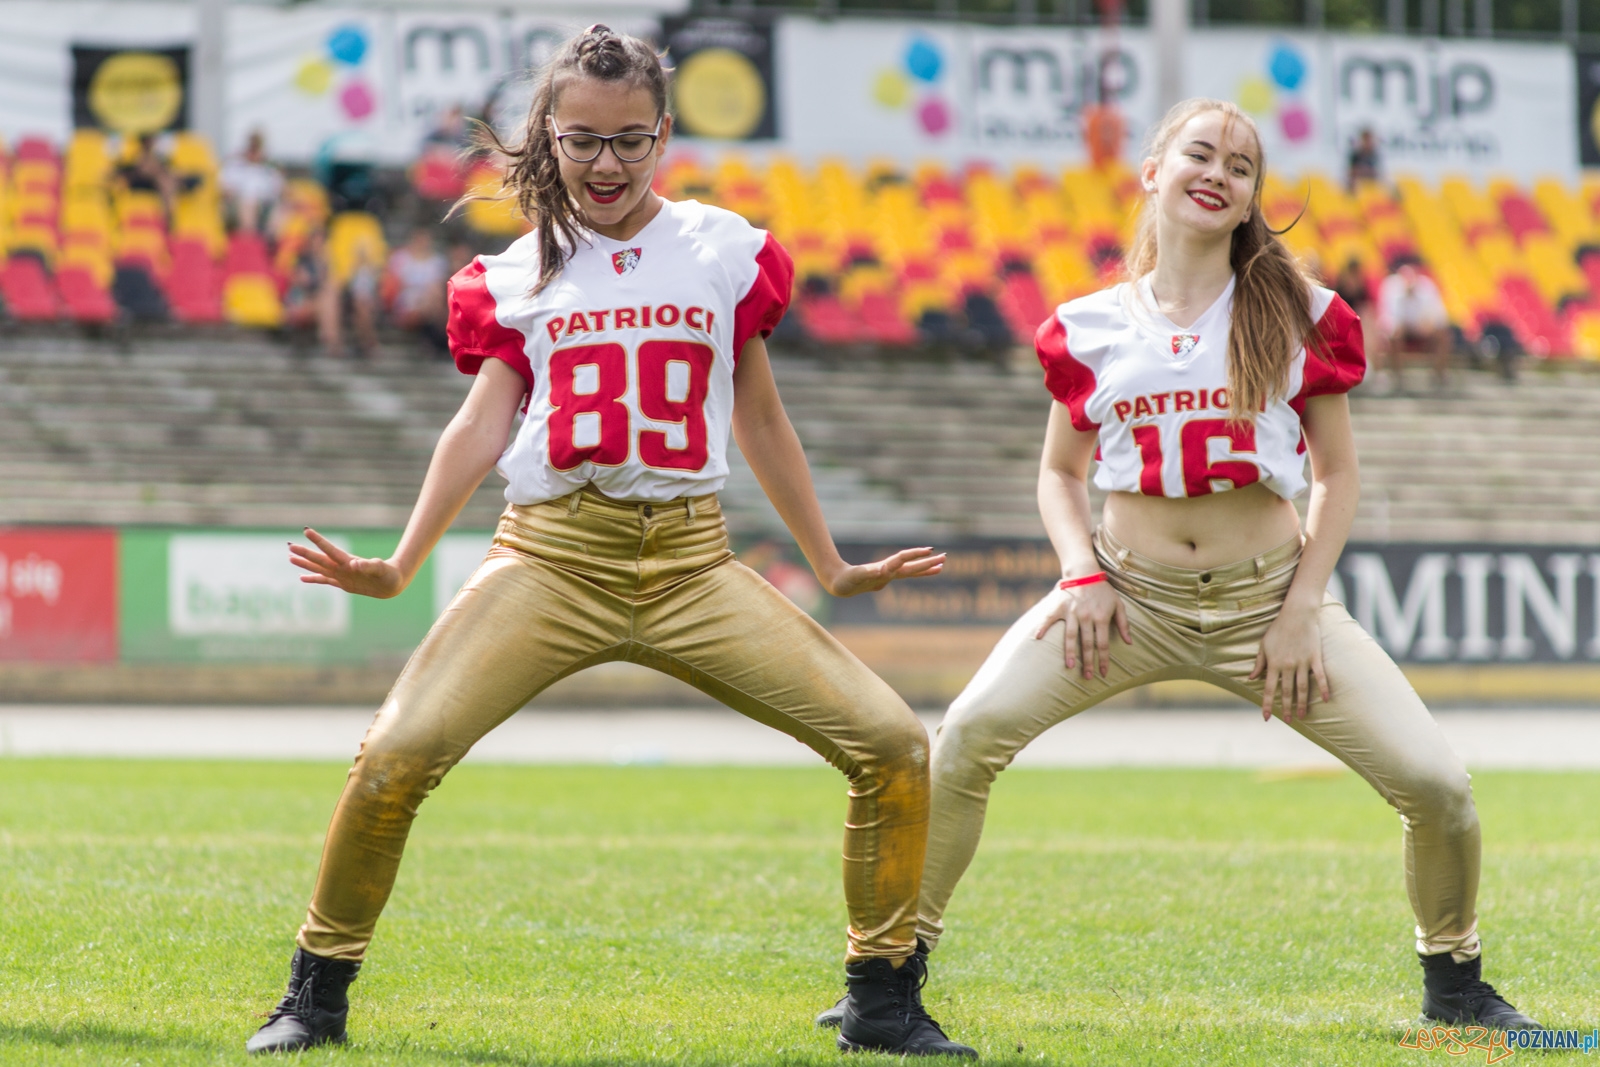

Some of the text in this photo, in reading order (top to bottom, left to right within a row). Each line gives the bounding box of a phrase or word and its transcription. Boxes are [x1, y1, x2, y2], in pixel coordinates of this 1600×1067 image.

[1340, 56, 1495, 131] mjp
[546, 303, 715, 344] PATRIOCI
[547, 339, 716, 473] 89
[1113, 387, 1268, 422] PATRIOI
[1130, 417, 1261, 498] 16
[1324, 552, 1600, 660] MIN
